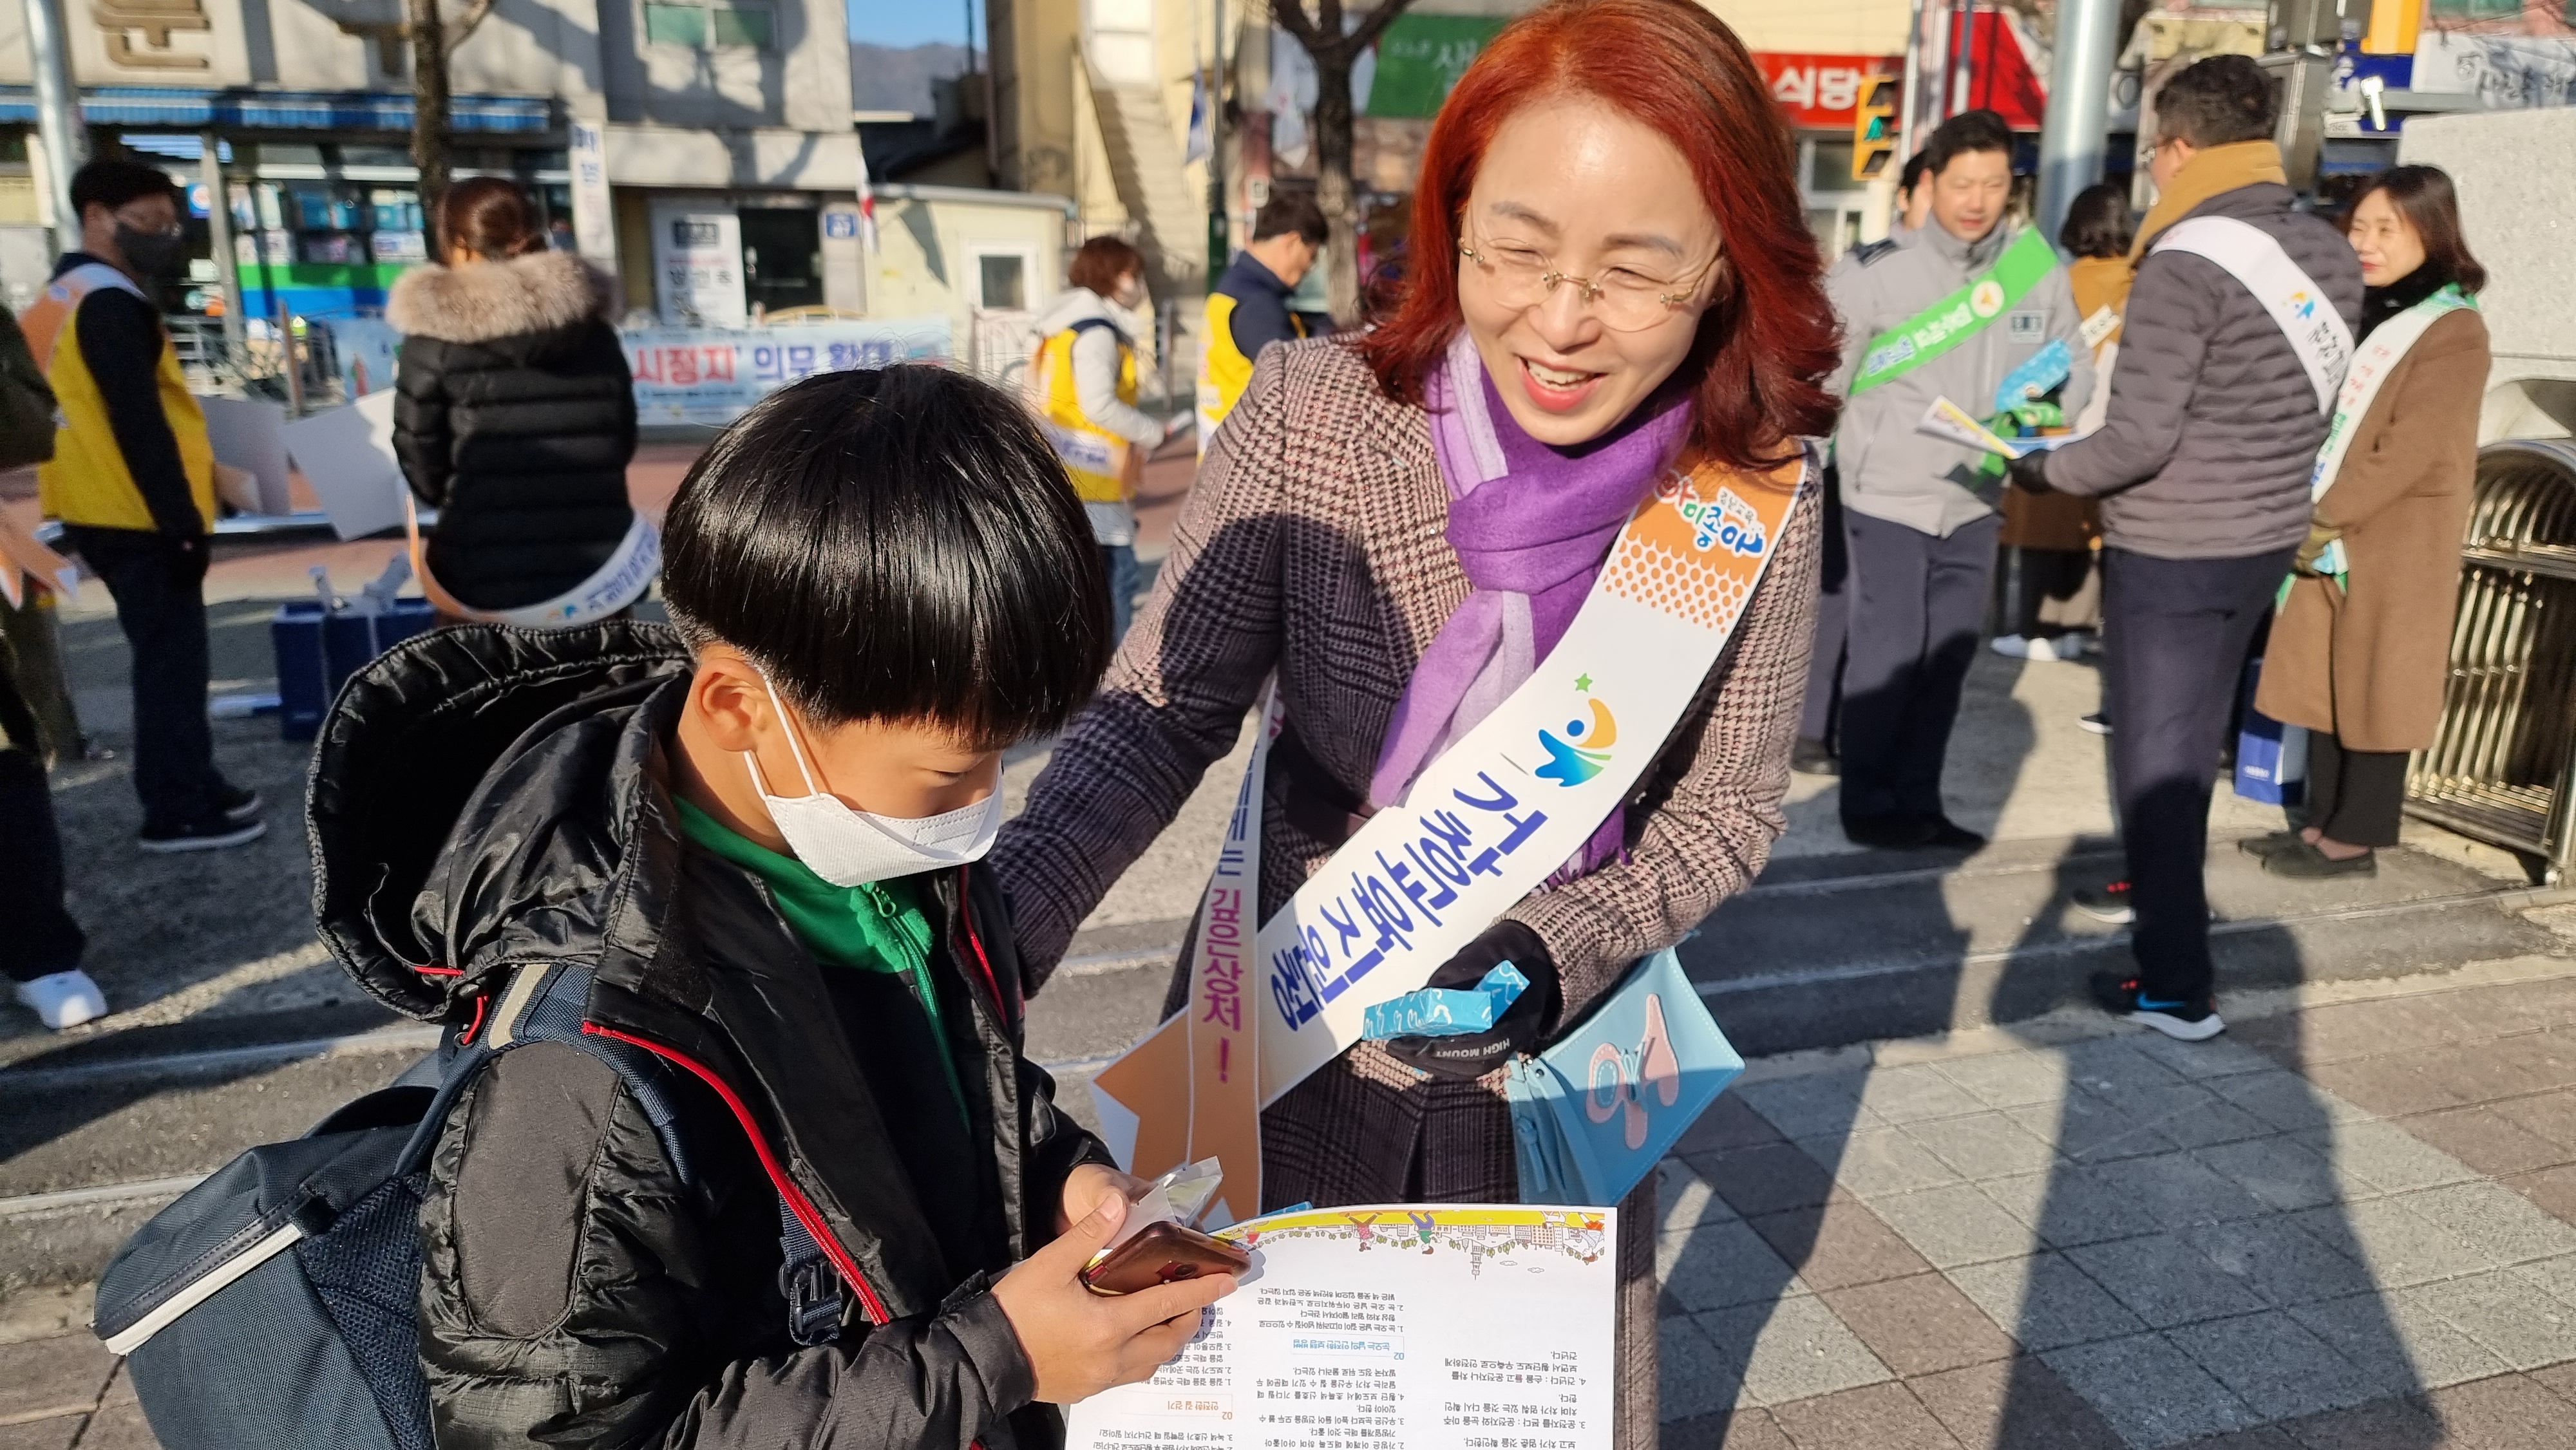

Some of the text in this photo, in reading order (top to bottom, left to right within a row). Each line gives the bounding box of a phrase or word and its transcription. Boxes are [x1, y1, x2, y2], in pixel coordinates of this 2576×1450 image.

[1774, 66, 1861, 110] 식당
[754, 343, 816, 381] 의무
[1271, 771, 1548, 1031] 거창교육지원청
[1436, 1037, 1510, 1058] HIGH MOUNT
[1202, 1332, 1224, 1341] 반드시
[1293, 1339, 1308, 1348] 방법
[1310, 1340, 1325, 1349] 보행
[1326, 1341, 1349, 1350] 안전한
[1351, 1341, 1365, 1350] 날의
[1551, 1351, 1577, 1360] 건넌다.
[1445, 1359, 1578, 1372] 보면서 횡단보도 우측으로 안전하게
[1452, 1371, 1468, 1380] 차를
[1471, 1373, 1504, 1382] 운전자나
[1526, 1375, 1542, 1384] 손을
[1209, 1378, 1223, 1386] 길을
[1331, 1380, 1352, 1388] 우산을
[1551, 1377, 1575, 1385] 건넌다
[1558, 1394, 1577, 1403] 한다.
[1168, 1401, 1218, 1410] 안전한 길 걷기
[1445, 1402, 1461, 1411] 확인
[1464, 1403, 1479, 1411] 다시
[1482, 1404, 1499, 1412] 것을
[1502, 1404, 1519, 1413] 있는
[1540, 1406, 1557, 1415] 차가
[1561, 1407, 1577, 1416] 치며
[1444, 1417, 1459, 1425] 마주
[1463, 1417, 1479, 1426] 눈을
[1482, 1417, 1515, 1426] 운전자와
[1523, 1418, 1539, 1427] 본다
[1543, 1419, 1576, 1429] 운전자를
[1099, 1429, 1122, 1438] 말아요!
[1464, 1438, 1498, 1447] 확인한다.
[1501, 1438, 1517, 1447] 것을
[1520, 1439, 1537, 1448] 멈춘
[1539, 1440, 1556, 1449] 차가
